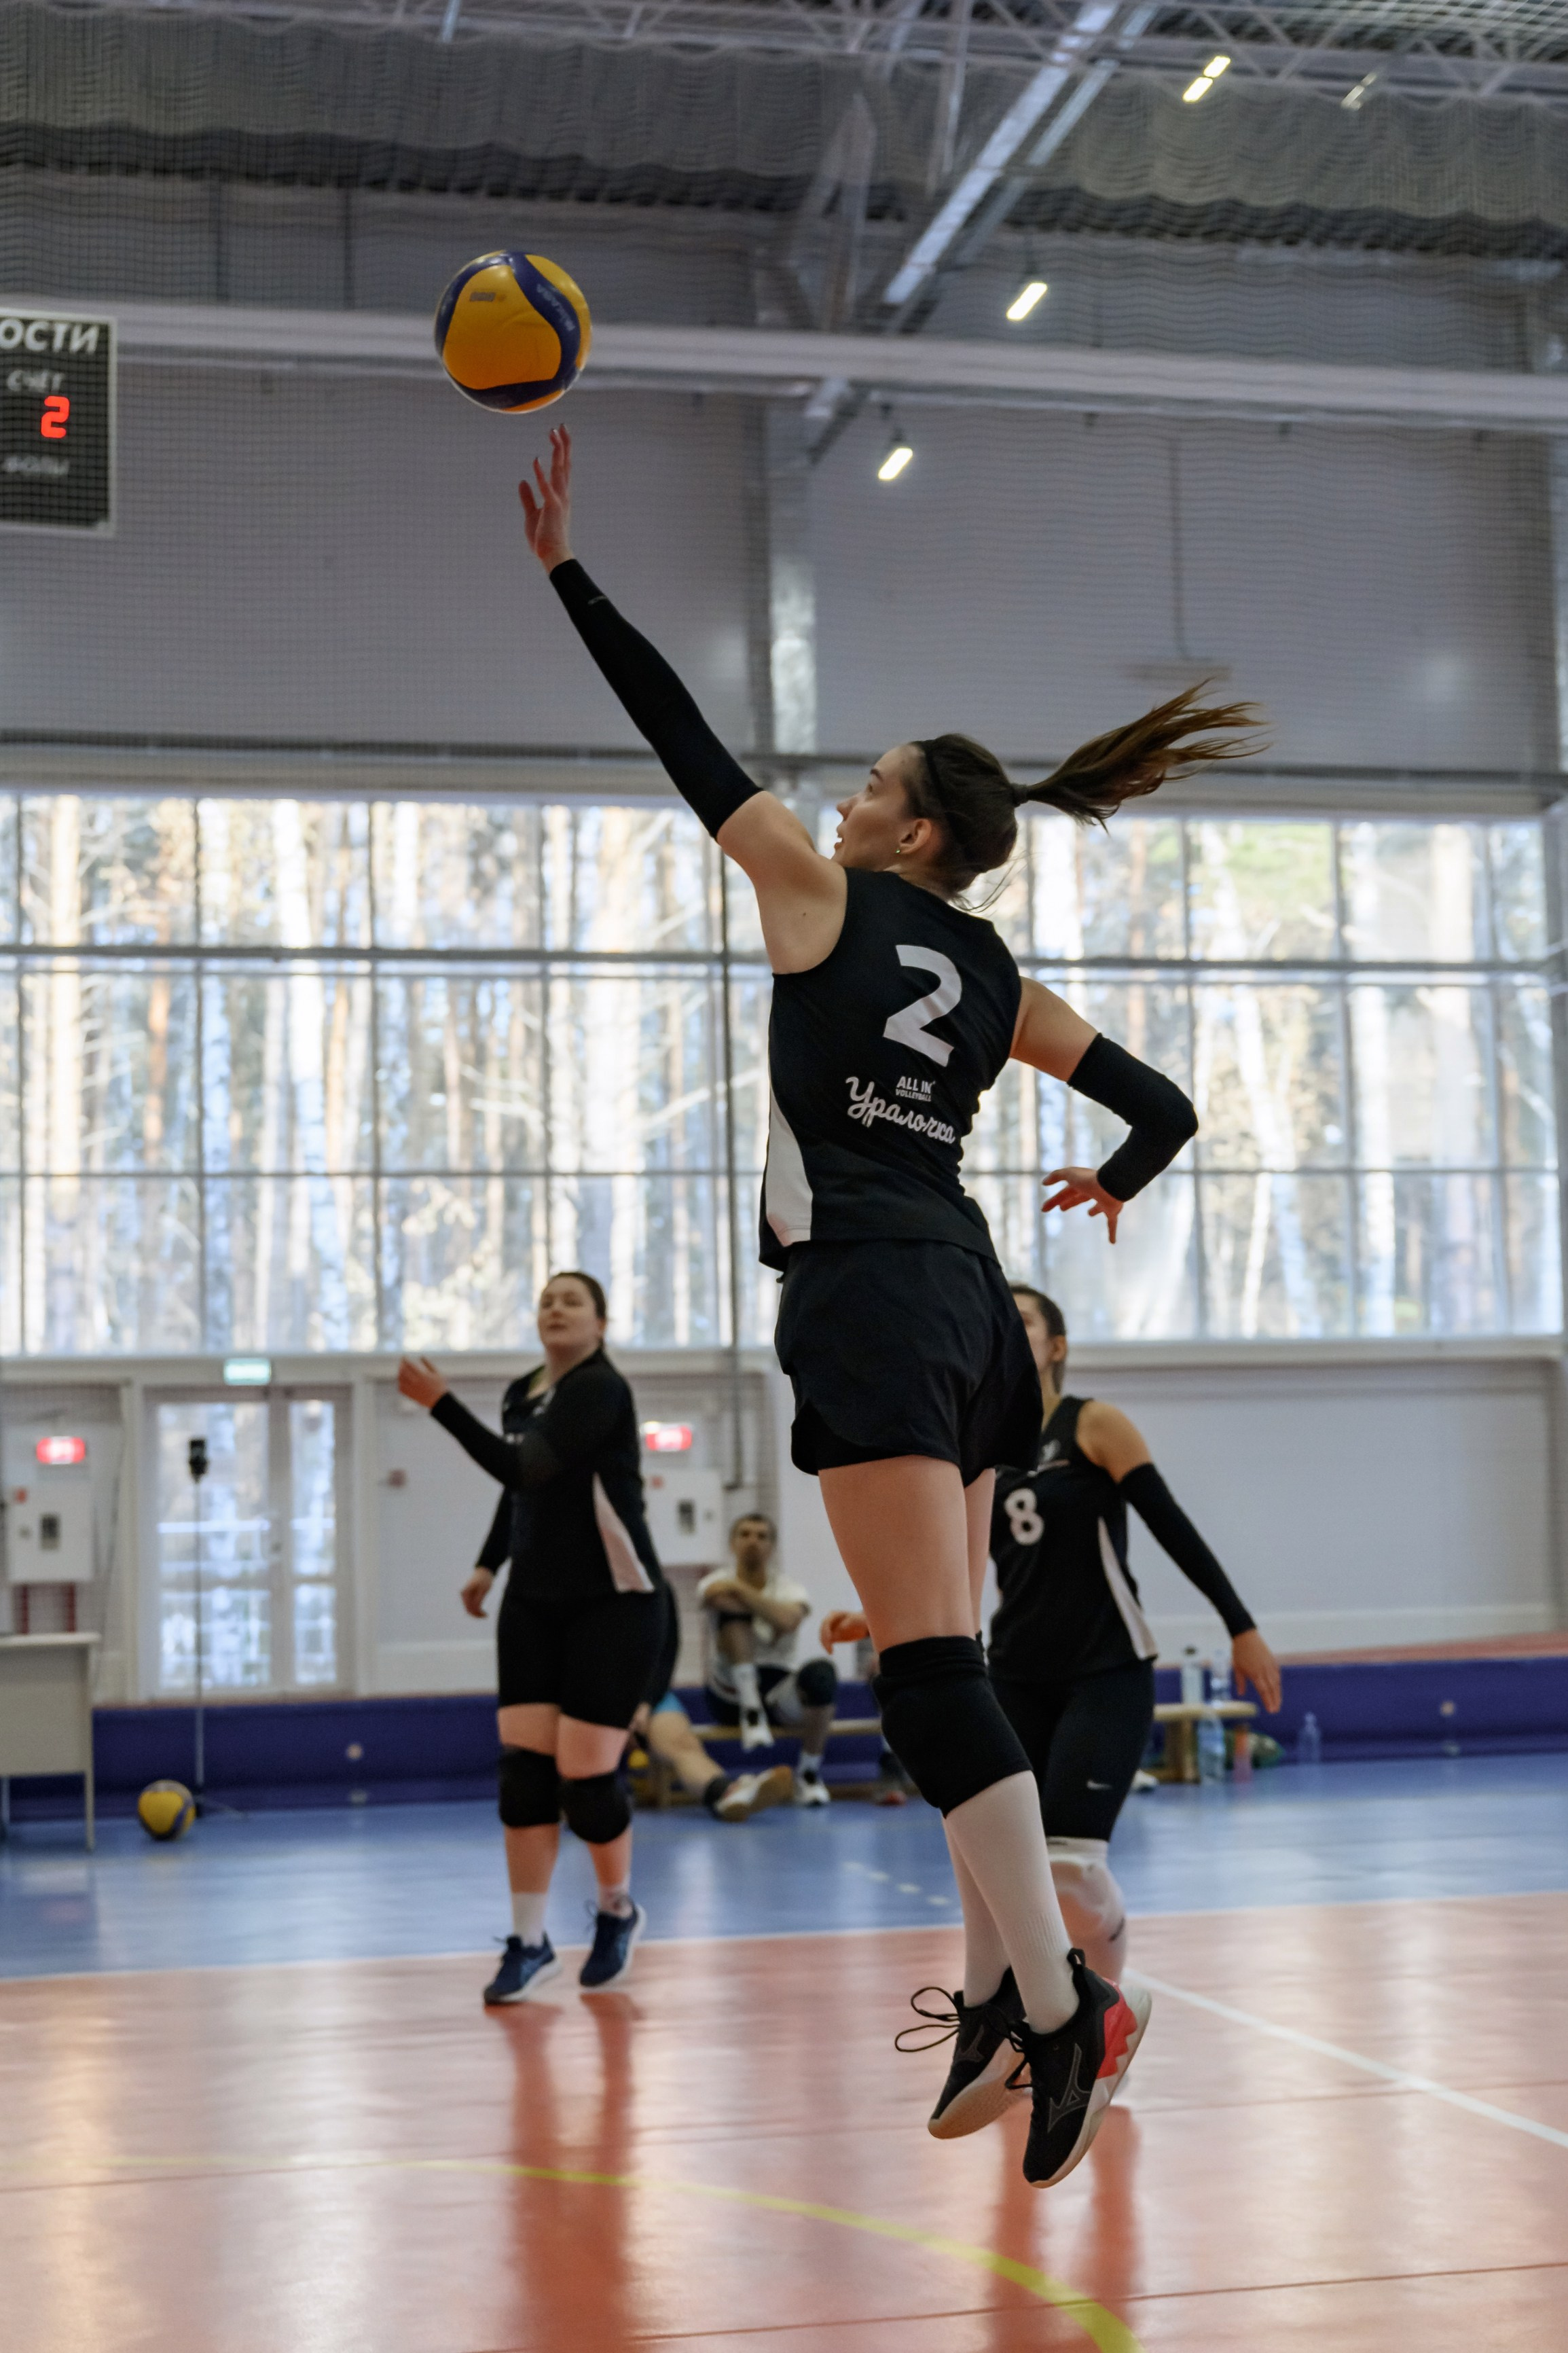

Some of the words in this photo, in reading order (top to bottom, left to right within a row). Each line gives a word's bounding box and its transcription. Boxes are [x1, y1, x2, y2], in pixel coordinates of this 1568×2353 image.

[41, 395, 70, 438] 2
[882, 944, 962, 1067] 2
[895, 1088, 932, 1102] VOLLEYBALL
[896, 1076, 919, 1092] ALL
[1004, 1488, 1044, 1546] 8
